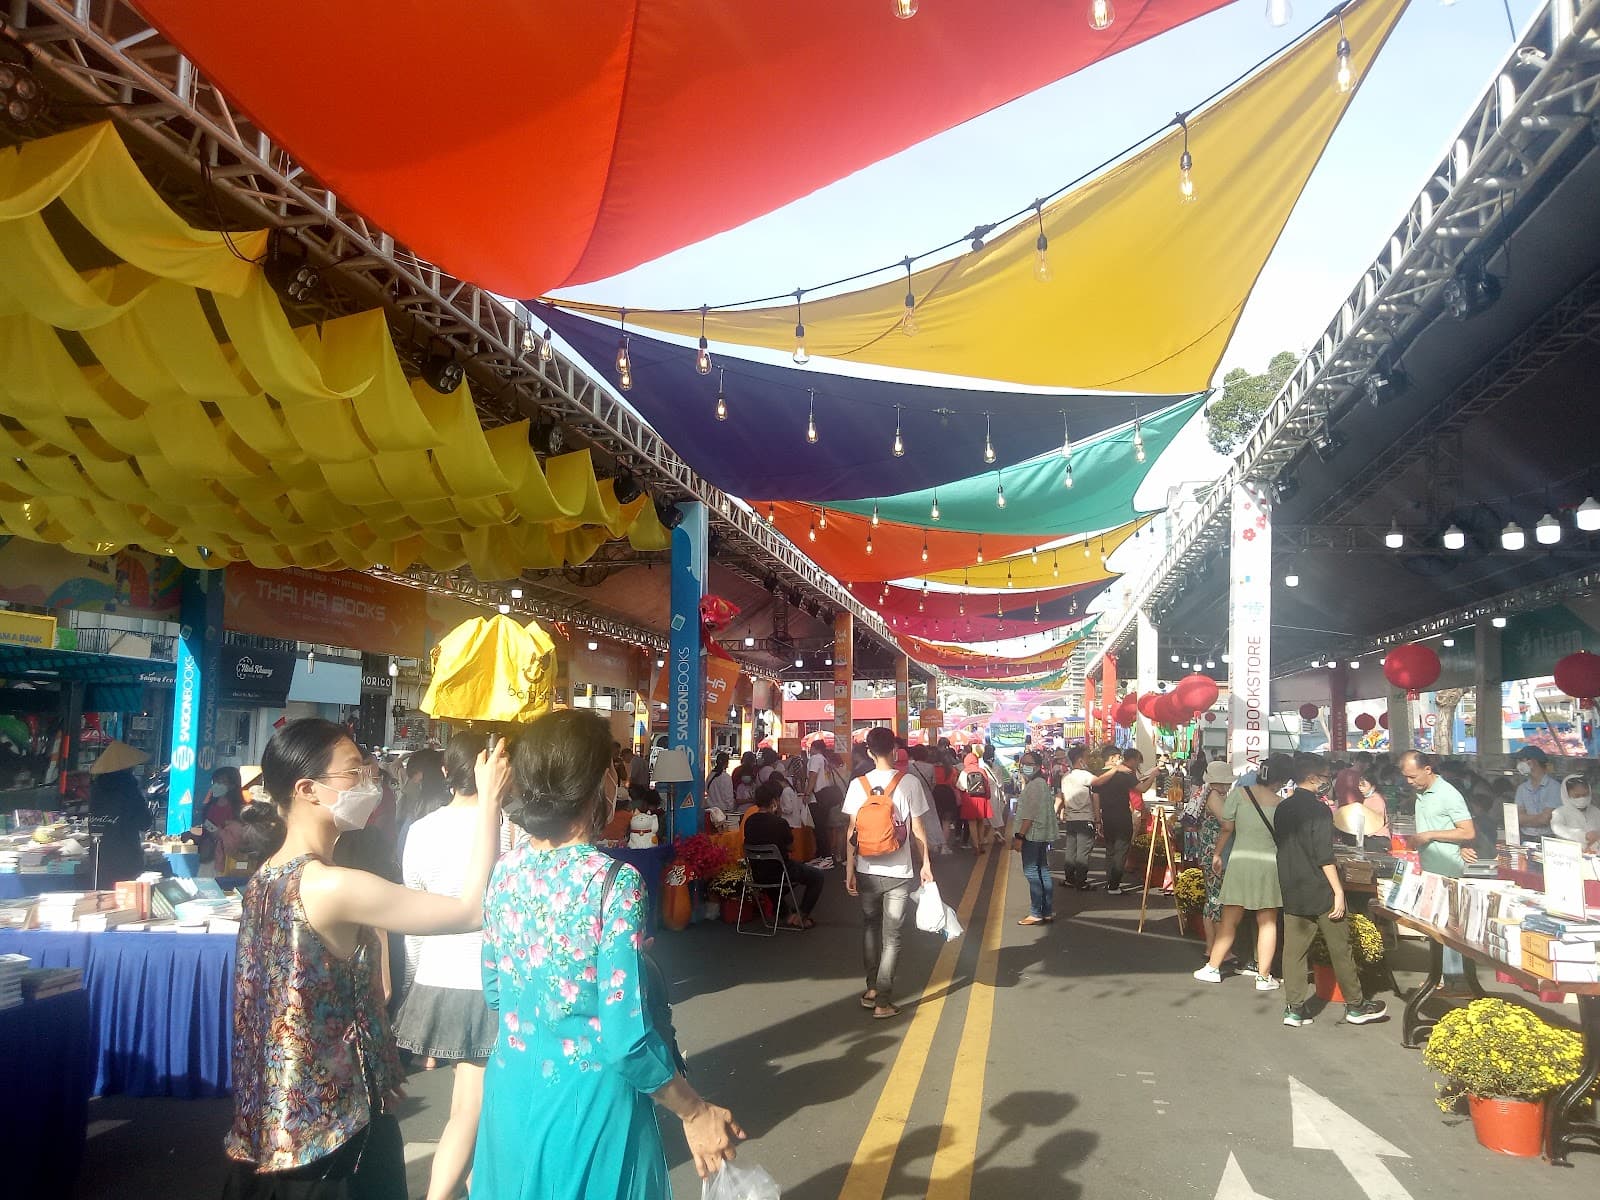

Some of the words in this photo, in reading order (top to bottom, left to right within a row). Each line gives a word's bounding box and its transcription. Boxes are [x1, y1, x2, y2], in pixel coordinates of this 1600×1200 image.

[331, 595, 386, 622] BOOKS
[179, 655, 195, 742] SAIGONBOOKS
[677, 647, 690, 740] SAIGONBOOKS
[1246, 636, 1261, 731] BOOKSTORE
